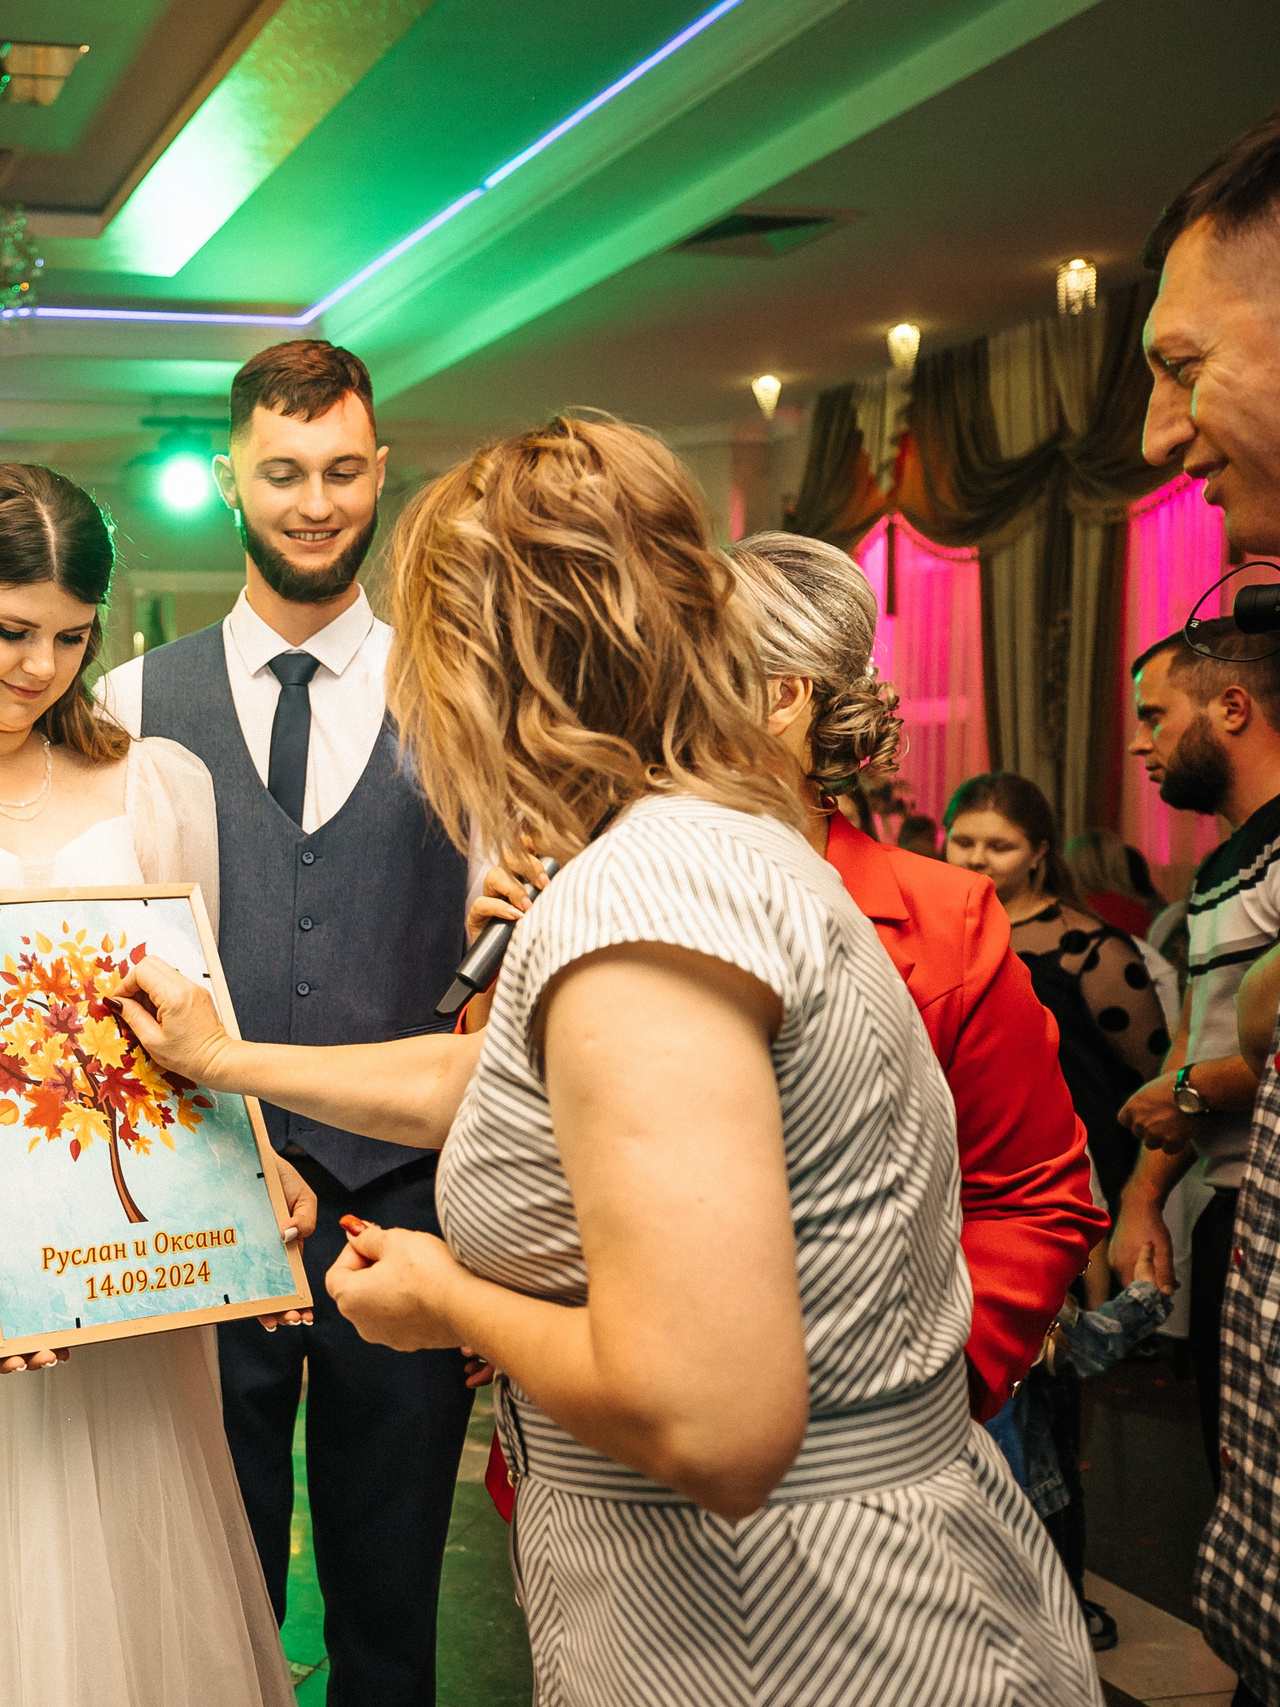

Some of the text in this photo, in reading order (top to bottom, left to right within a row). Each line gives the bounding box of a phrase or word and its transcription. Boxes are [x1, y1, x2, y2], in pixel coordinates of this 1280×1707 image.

[41, 1226, 237, 1274] Руслан и Оксана
[86, 1260, 212, 1300] 14.09.2024
